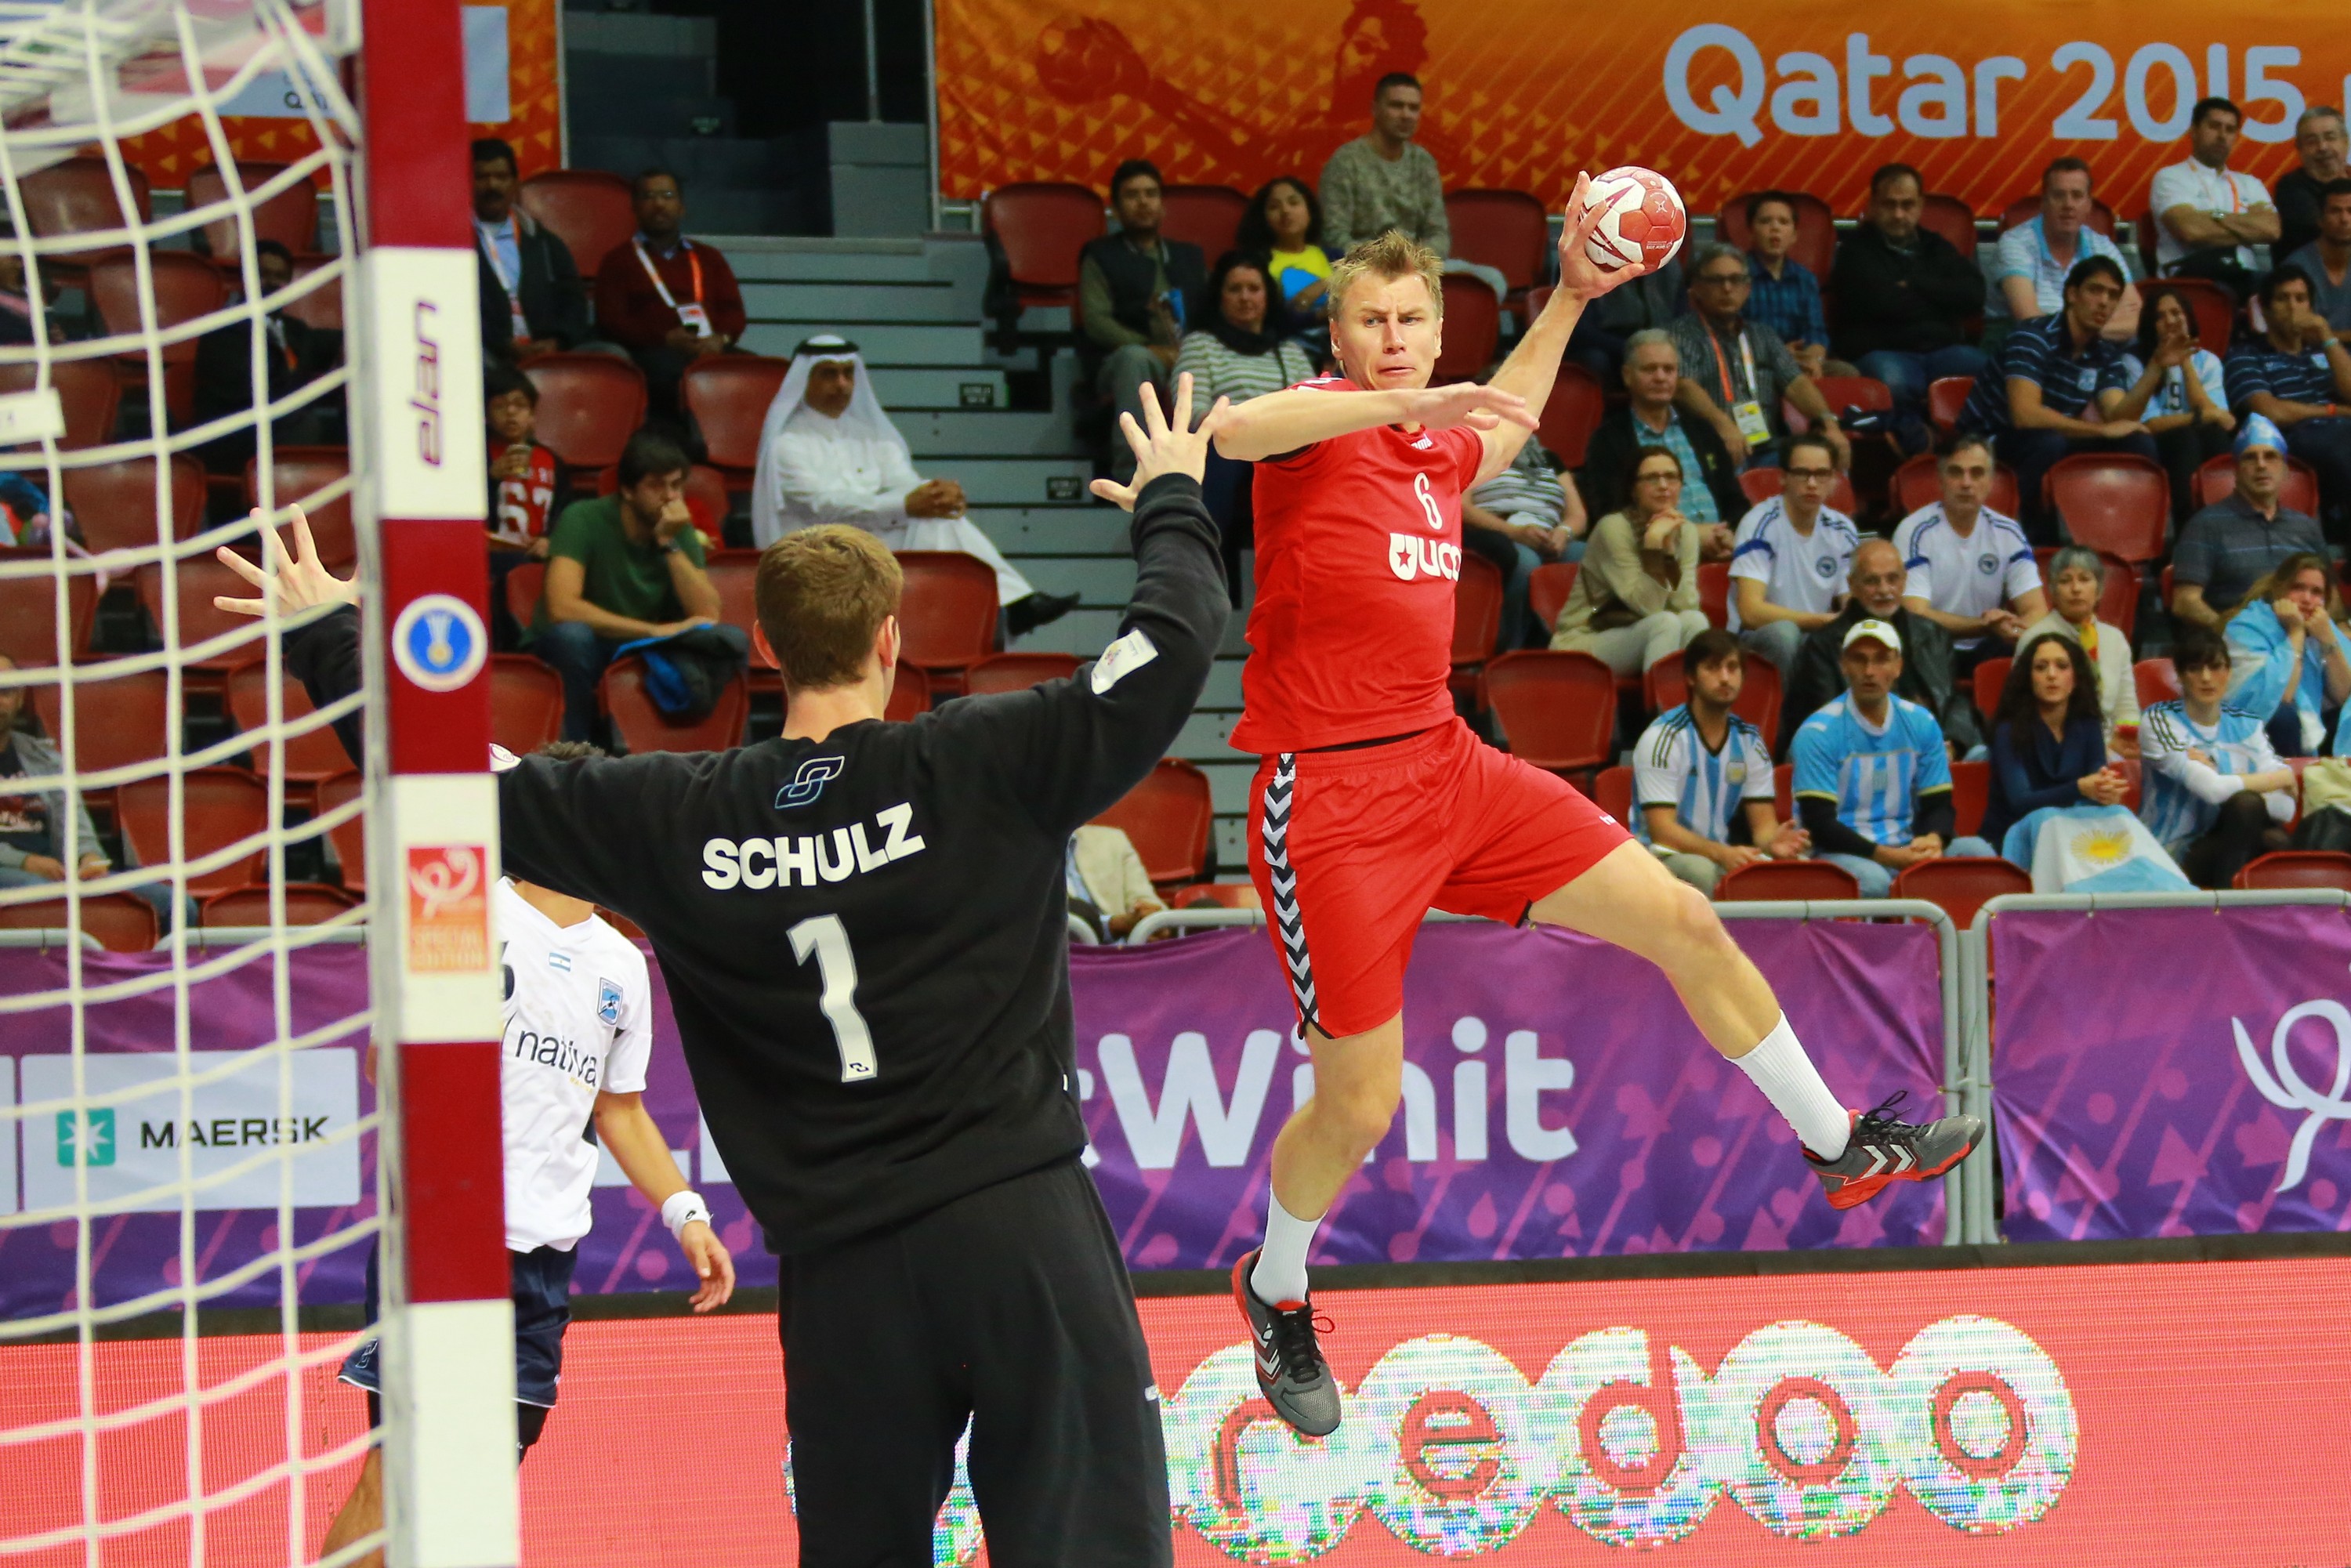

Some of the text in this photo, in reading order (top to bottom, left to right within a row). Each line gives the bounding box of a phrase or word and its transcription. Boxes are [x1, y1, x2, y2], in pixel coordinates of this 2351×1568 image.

[1662, 23, 2027, 150] Qatar
[2051, 41, 2306, 143] 2015
[1414, 472, 1444, 531] 6
[701, 802, 926, 890] SCHULZ
[786, 913, 878, 1083] 1
[515, 1030, 598, 1088] nativa
